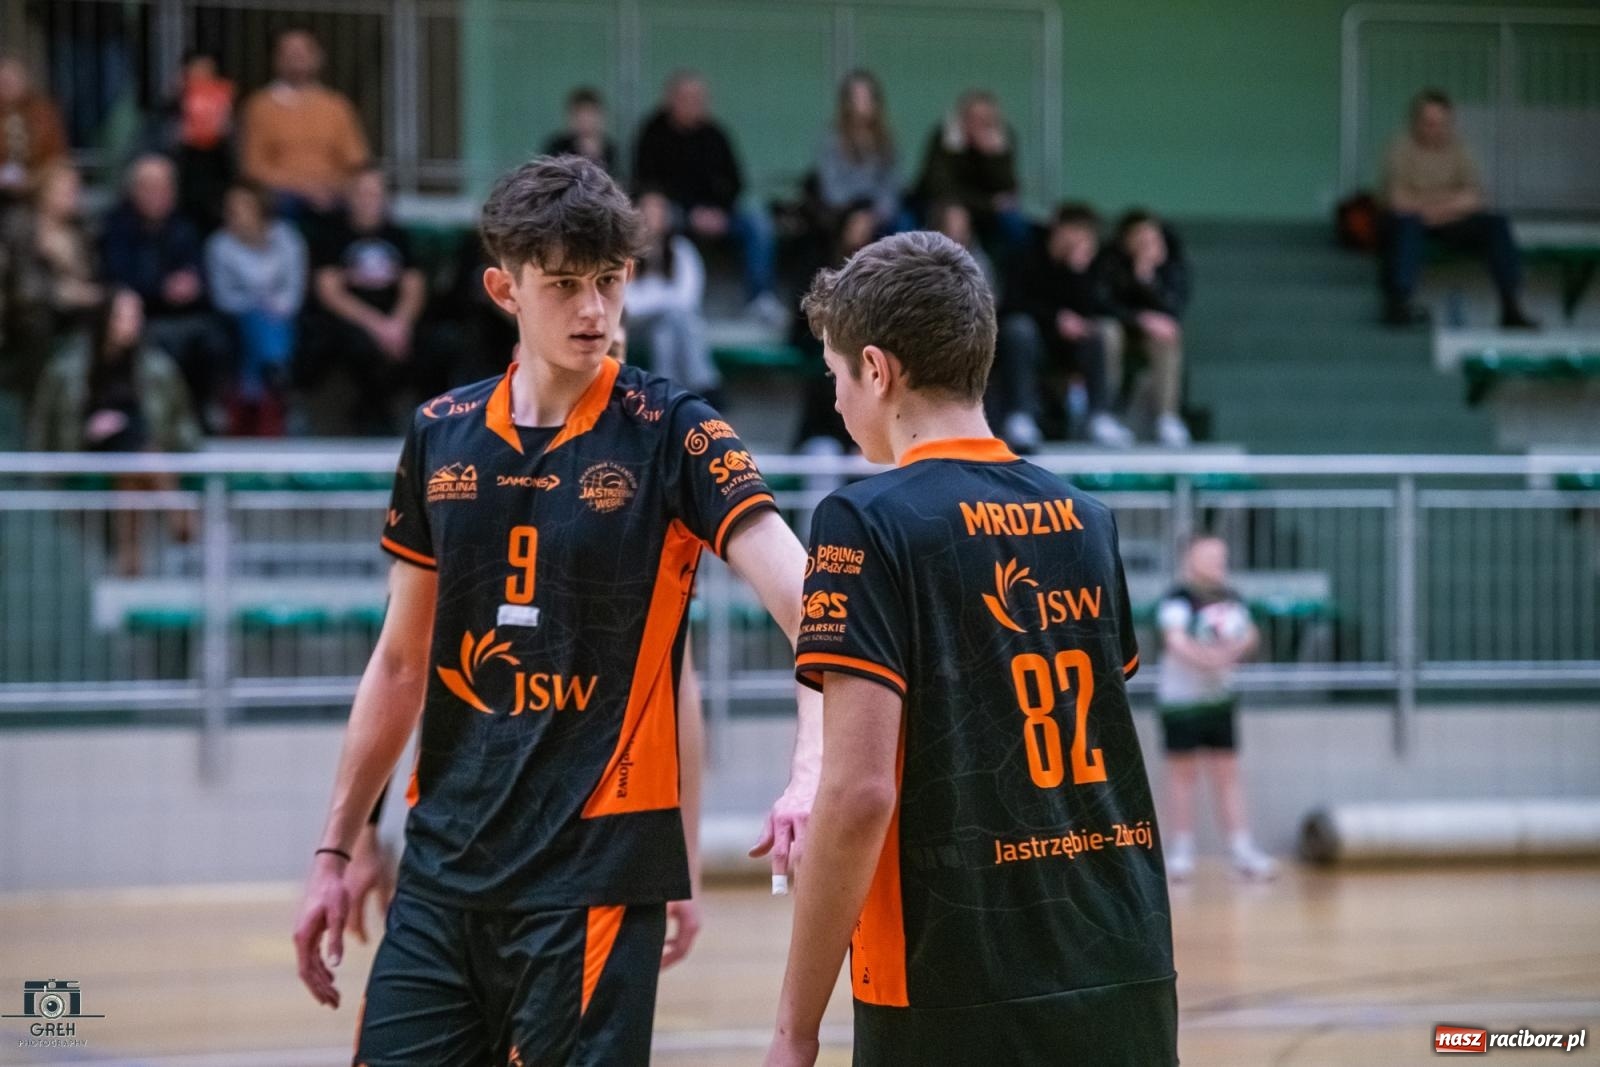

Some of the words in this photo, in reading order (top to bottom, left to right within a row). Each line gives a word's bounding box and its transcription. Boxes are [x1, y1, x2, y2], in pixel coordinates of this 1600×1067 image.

[427, 482, 478, 495] CAROLINA
[959, 498, 1084, 536] MROZIK
[504, 525, 538, 605] 9
[1038, 586, 1101, 631] JSW
[509, 672, 598, 716] JSW
[1011, 649, 1108, 788] 82
[995, 821, 1153, 864] Jastrzębie-Zdrój
